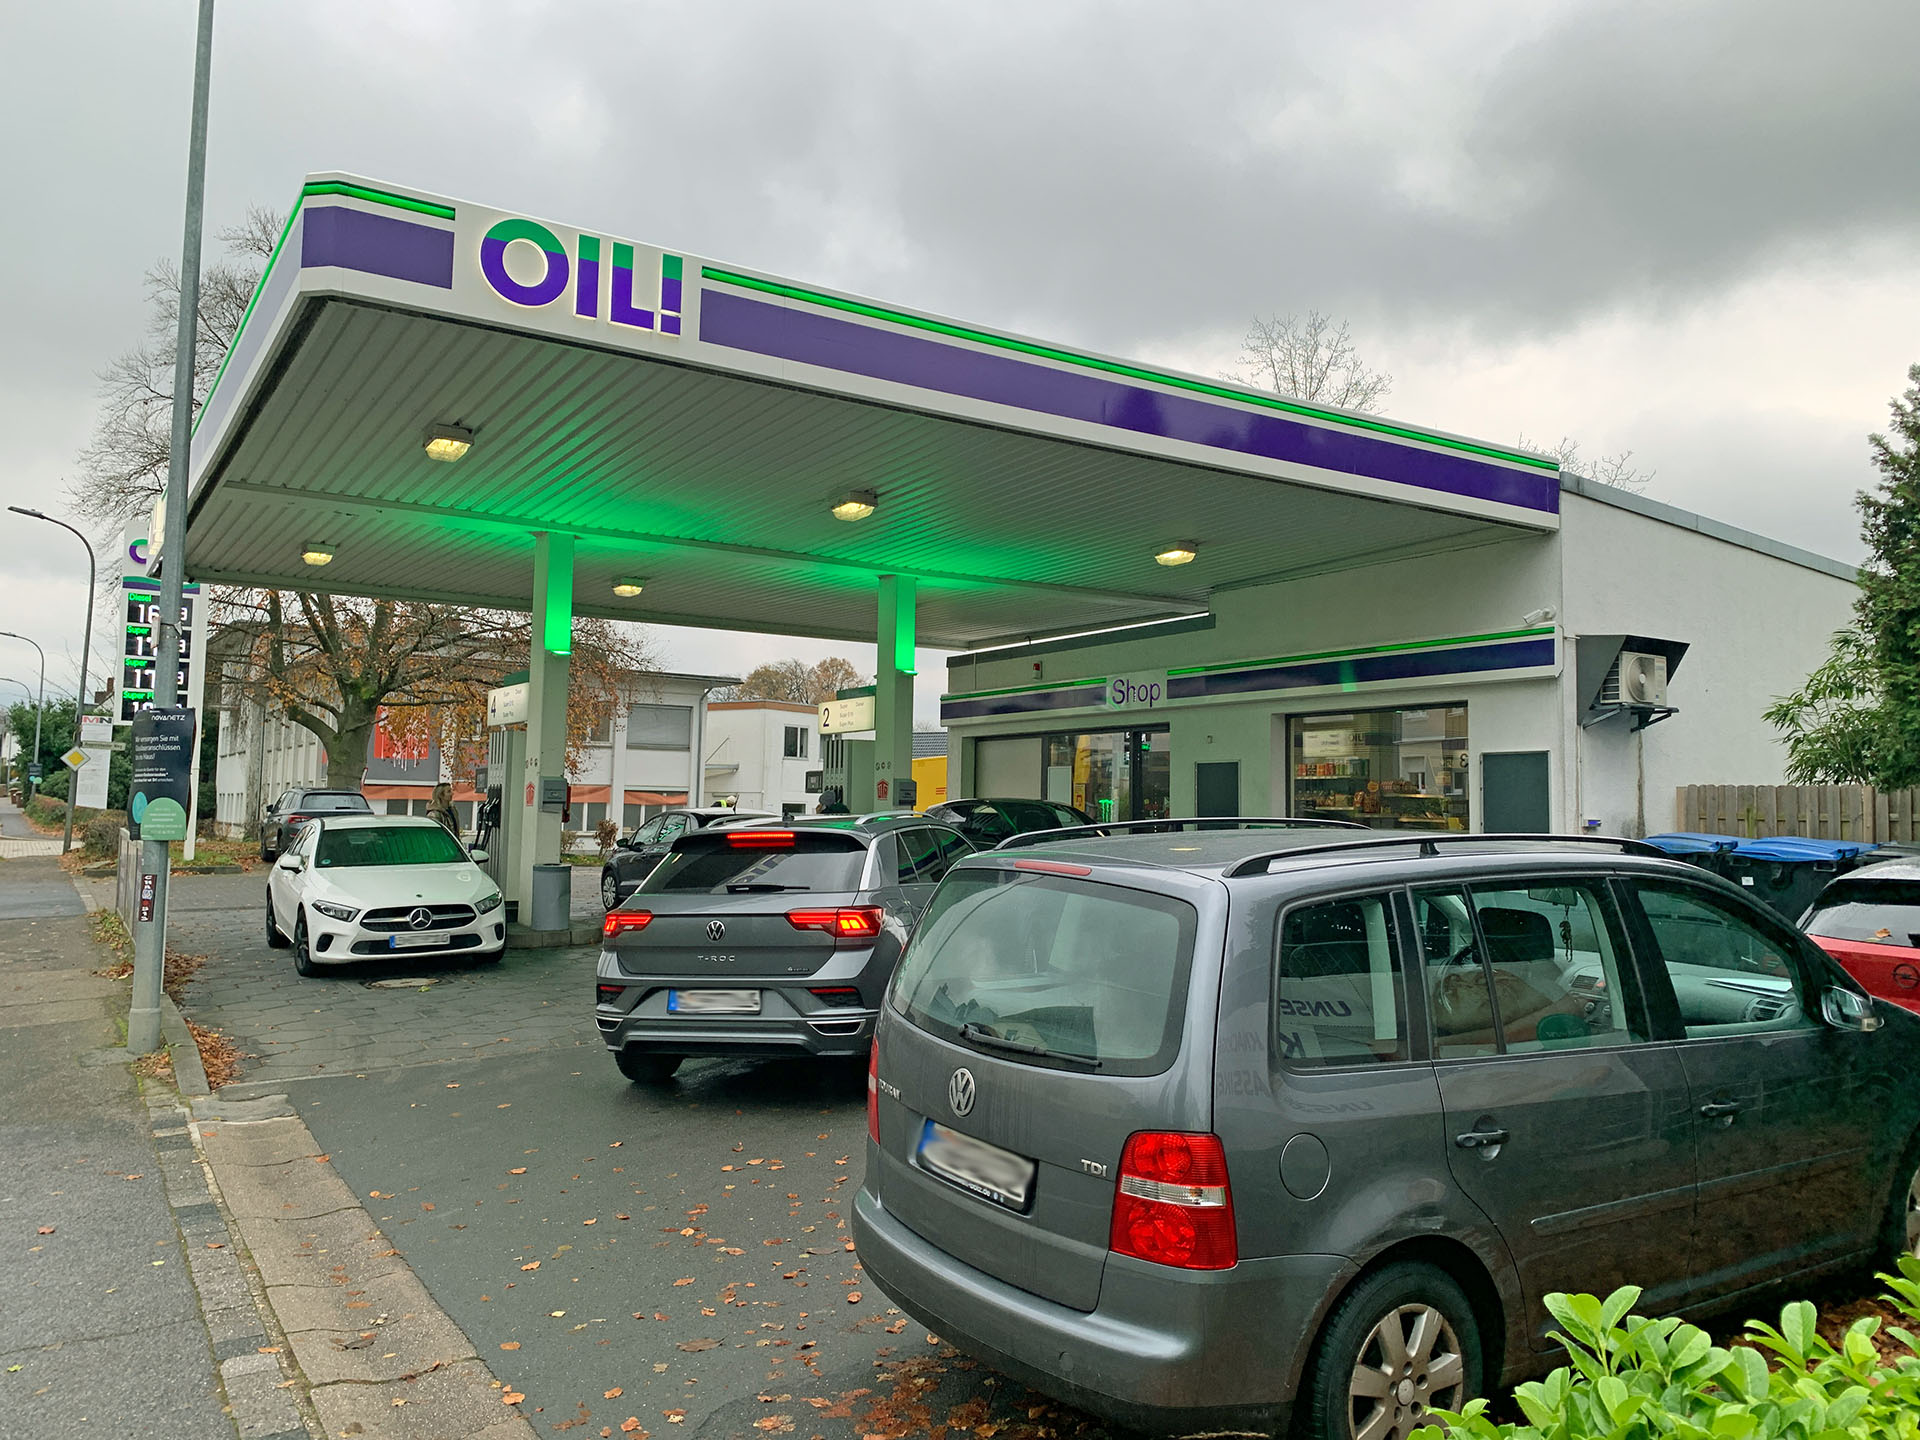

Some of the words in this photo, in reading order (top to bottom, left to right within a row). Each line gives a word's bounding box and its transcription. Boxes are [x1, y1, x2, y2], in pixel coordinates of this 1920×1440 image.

[480, 218, 683, 337] OIL!
[129, 593, 152, 602] Diesel
[127, 626, 150, 636] Super
[125, 658, 148, 668] Super
[123, 690, 146, 701] Super
[1112, 679, 1161, 708] Shop
[491, 695, 497, 718] 4
[823, 707, 830, 727] 2
[159, 734, 168, 742] Sie
[1080, 1158, 1108, 1178] TDI
